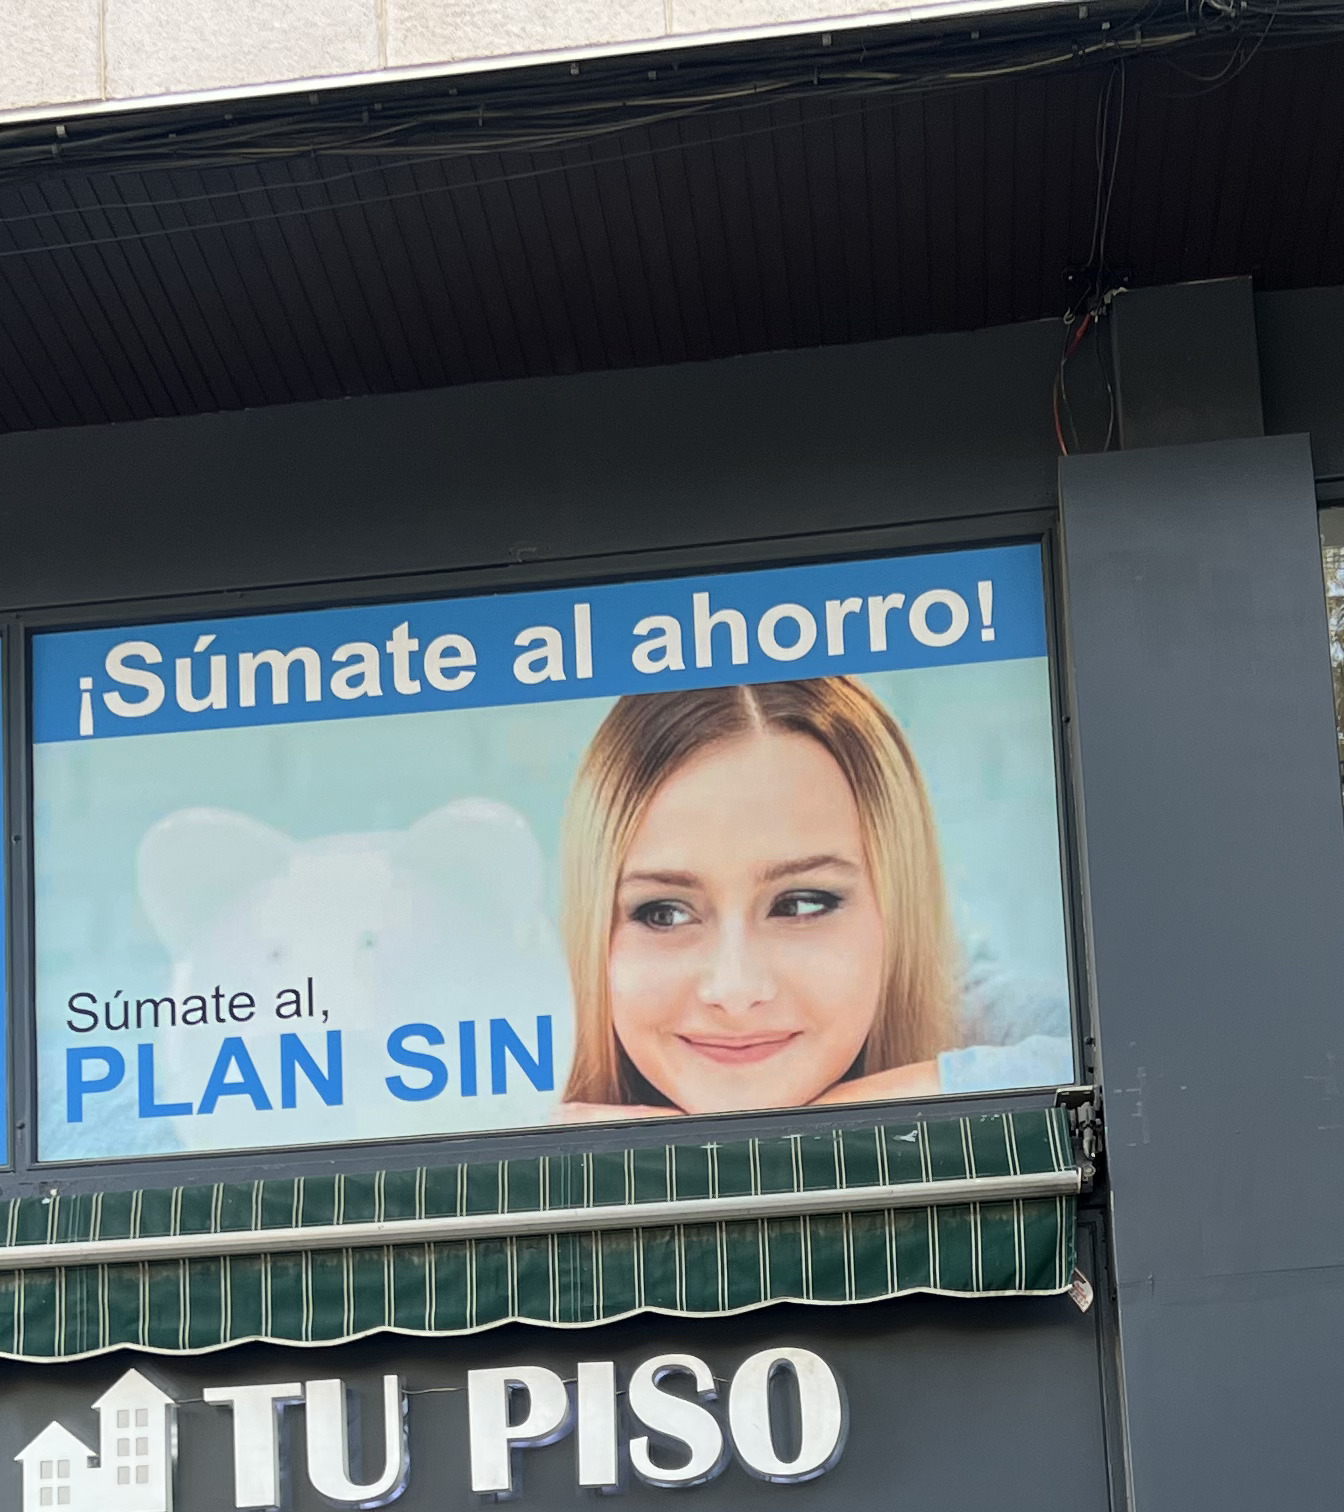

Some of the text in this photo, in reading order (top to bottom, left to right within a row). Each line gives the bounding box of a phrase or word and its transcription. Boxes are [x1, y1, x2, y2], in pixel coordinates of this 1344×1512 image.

[77, 579, 997, 736] ¡Súmate al ahorro!
[65, 977, 331, 1033] Súmate al,
[65, 1014, 555, 1125] PLAN SIN
[203, 1347, 848, 1512] TU PISO
